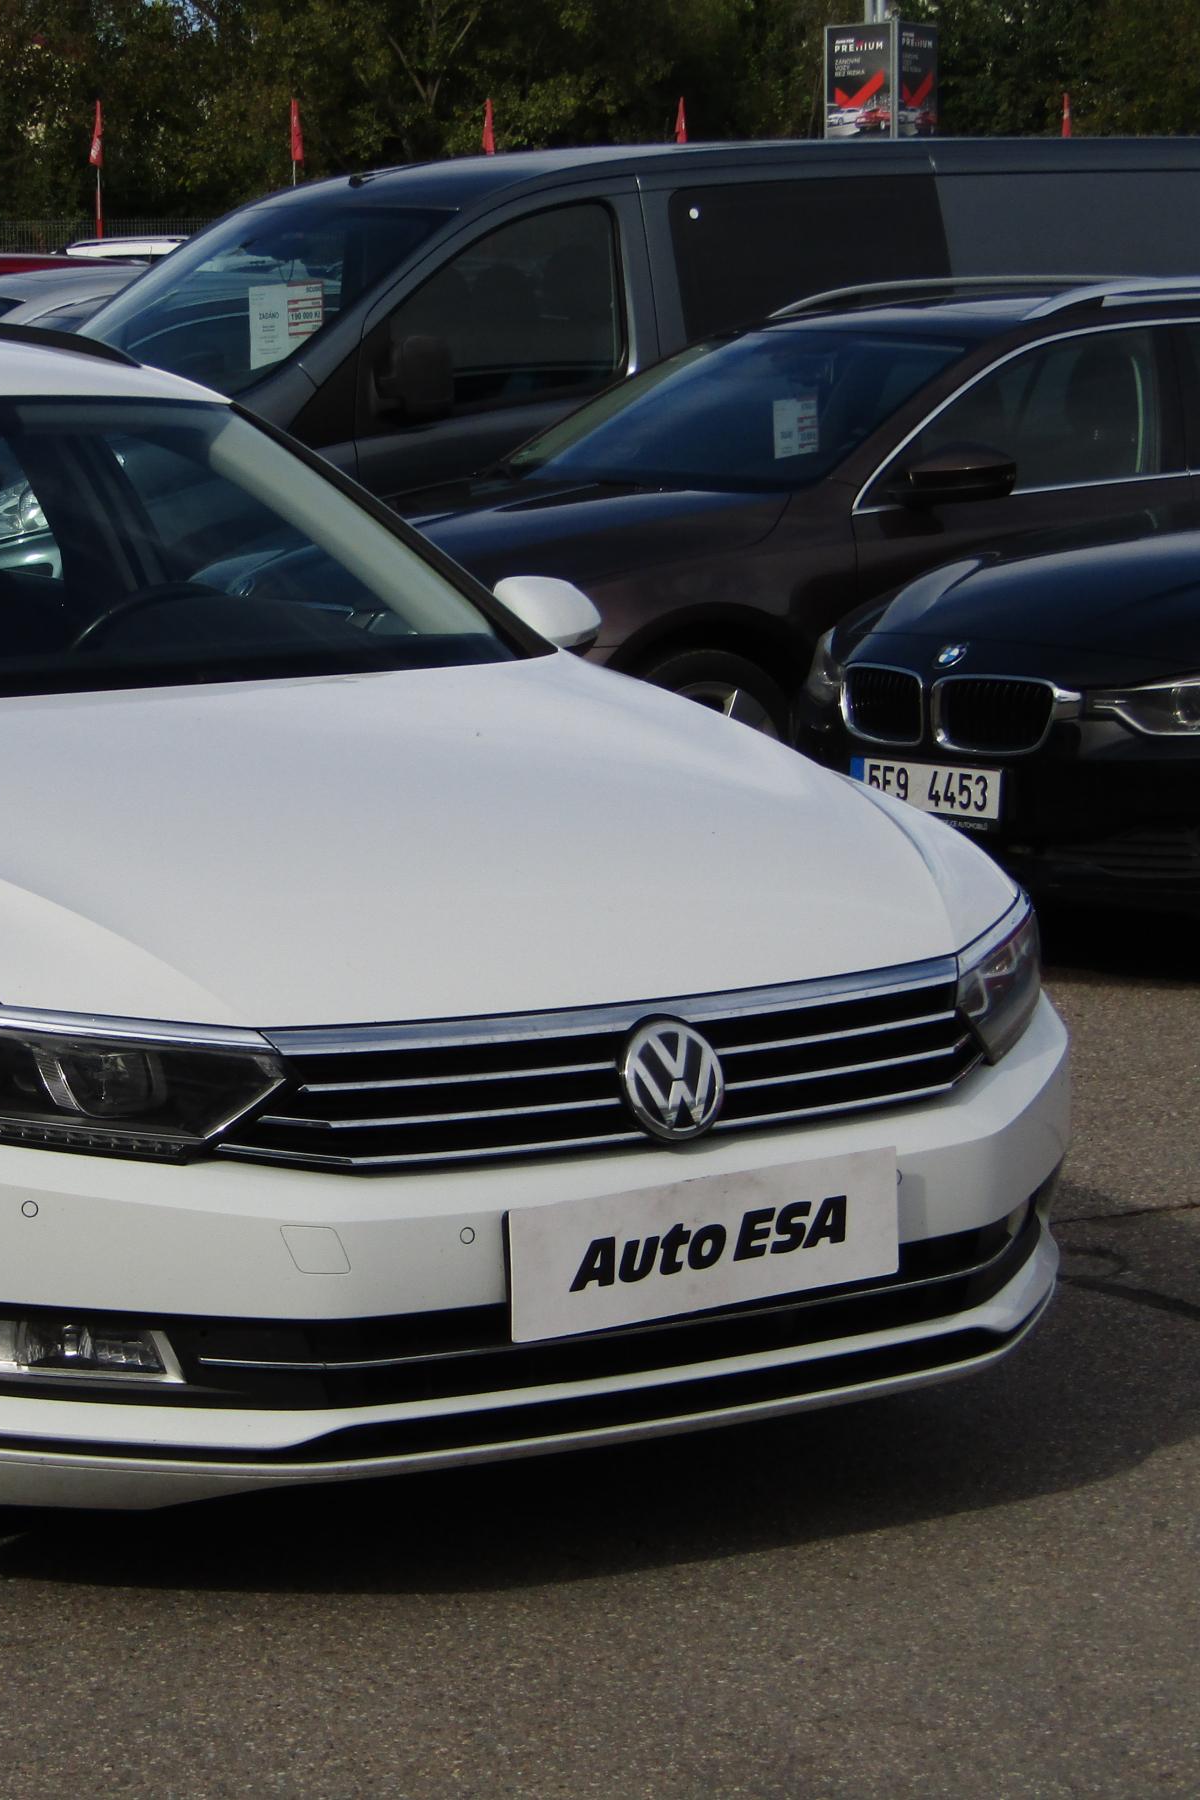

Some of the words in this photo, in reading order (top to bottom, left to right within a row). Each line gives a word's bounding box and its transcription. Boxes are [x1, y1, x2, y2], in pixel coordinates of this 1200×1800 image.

[928, 770, 988, 811] 4453
[568, 1222, 727, 1292] Auto
[733, 1195, 847, 1261] ESA
